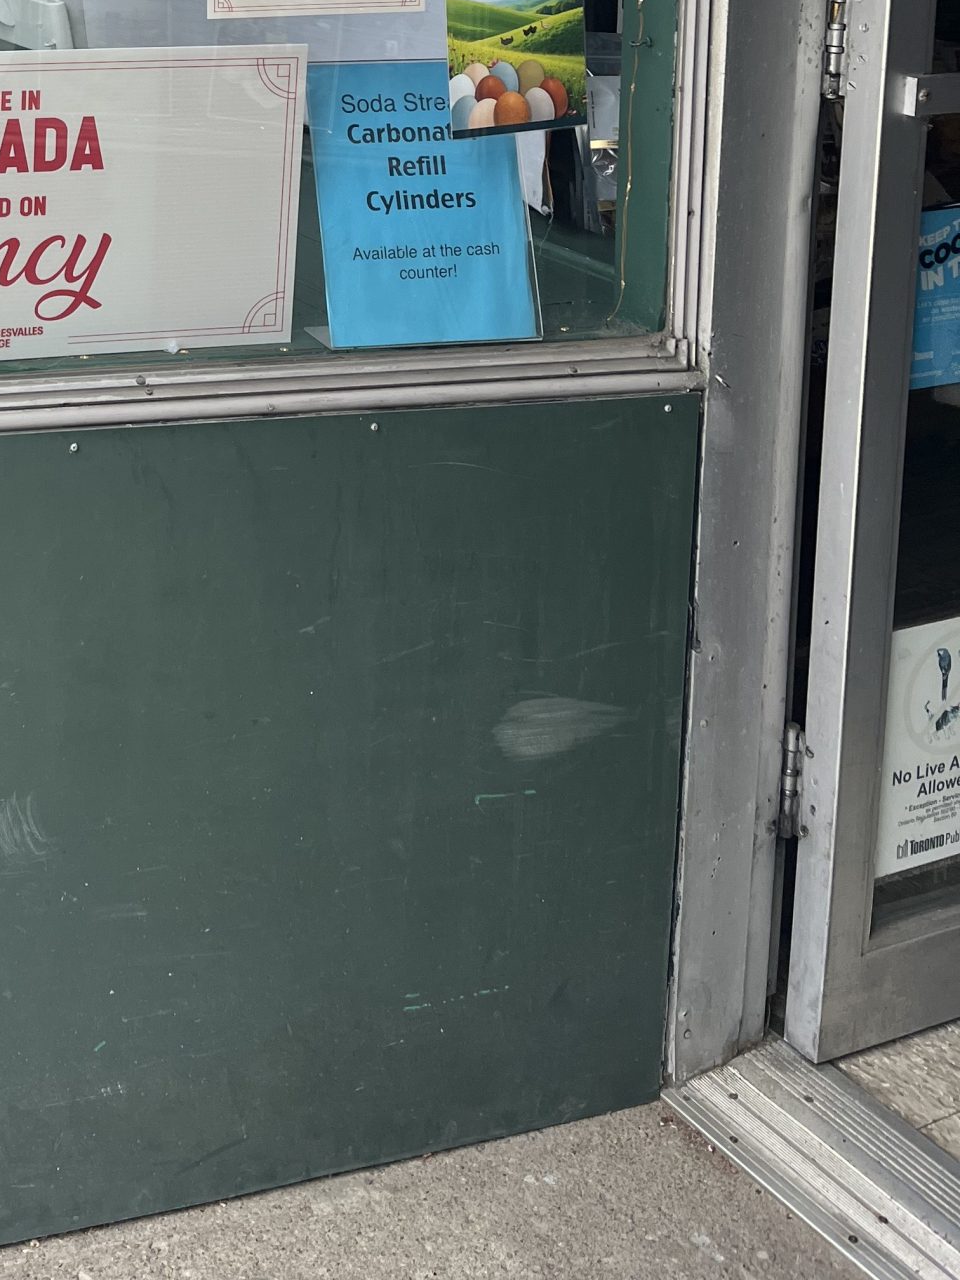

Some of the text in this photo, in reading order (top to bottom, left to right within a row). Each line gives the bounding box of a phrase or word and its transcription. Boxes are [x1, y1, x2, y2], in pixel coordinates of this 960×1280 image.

[21, 90, 40, 110] IN
[341, 94, 397, 114] Soda
[347, 124, 452, 144] Carbonat
[387, 155, 447, 177] Refill
[19, 196, 47, 216] ON
[366, 189, 477, 215] Cylinders
[919, 225, 951, 247] KEEP
[352, 242, 500, 261] Available at the cash
[399, 265, 458, 280] counter!
[921, 267, 944, 291] IN
[892, 770, 912, 786] No
[916, 762, 946, 780] Live
[909, 834, 945, 856] TORONTO
